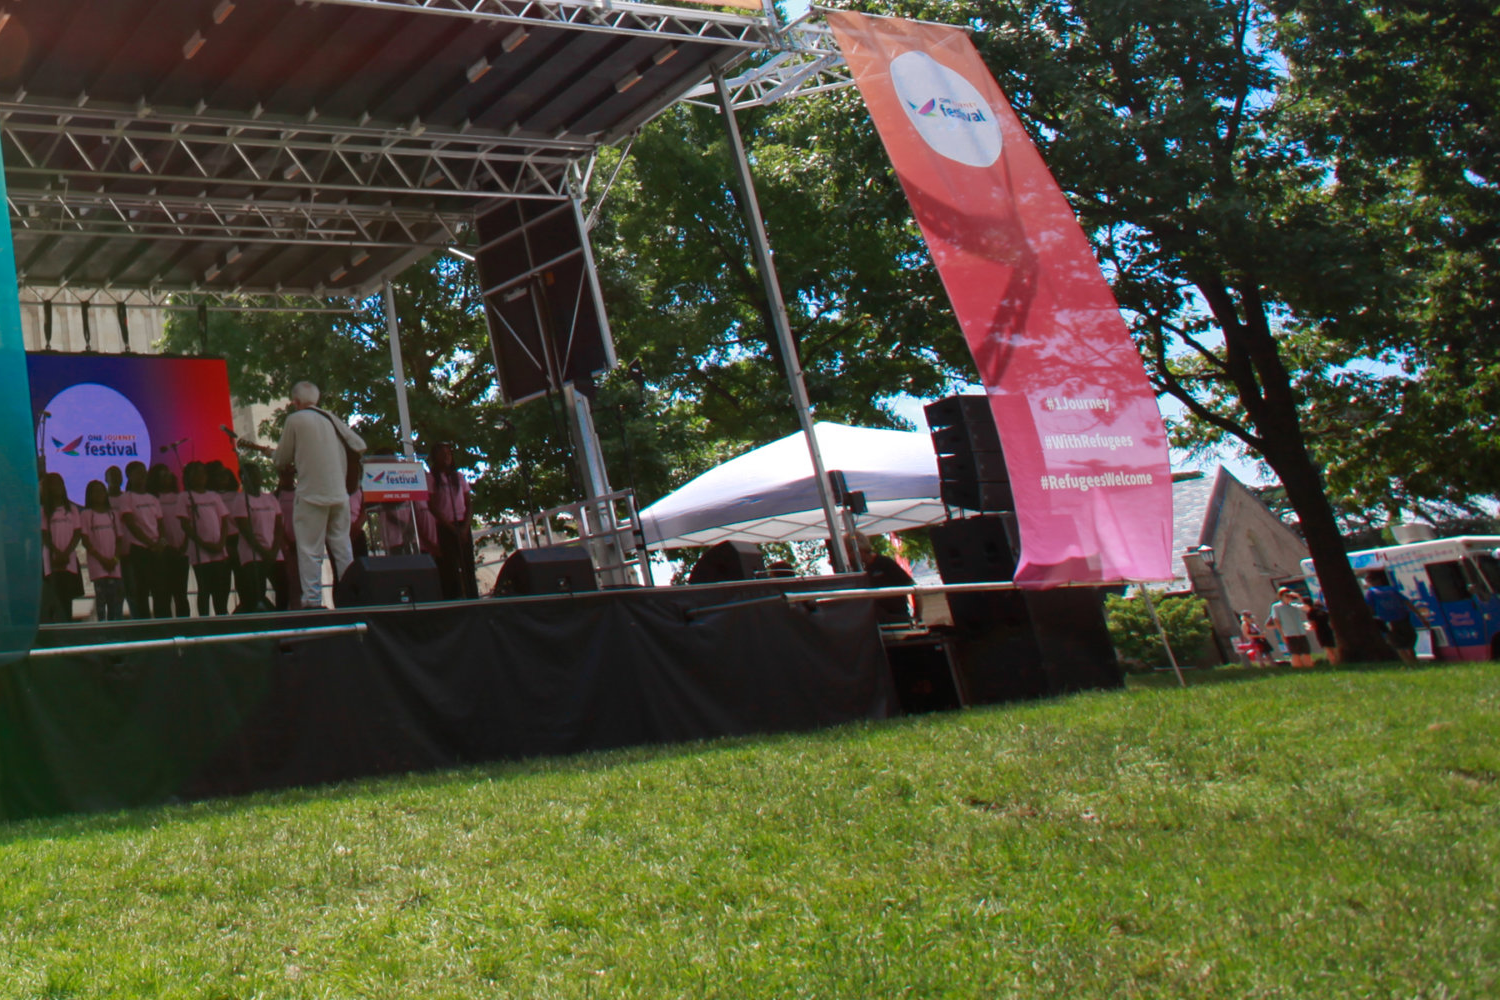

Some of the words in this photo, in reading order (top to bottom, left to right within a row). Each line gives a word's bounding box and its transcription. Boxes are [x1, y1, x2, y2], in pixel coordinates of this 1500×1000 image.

[1046, 396, 1110, 412] #1Journey
[85, 441, 139, 457] festival
[1044, 433, 1134, 451] #WithRefugees
[386, 473, 419, 485] festival
[1040, 471, 1153, 492] #RefugeesWelcome
